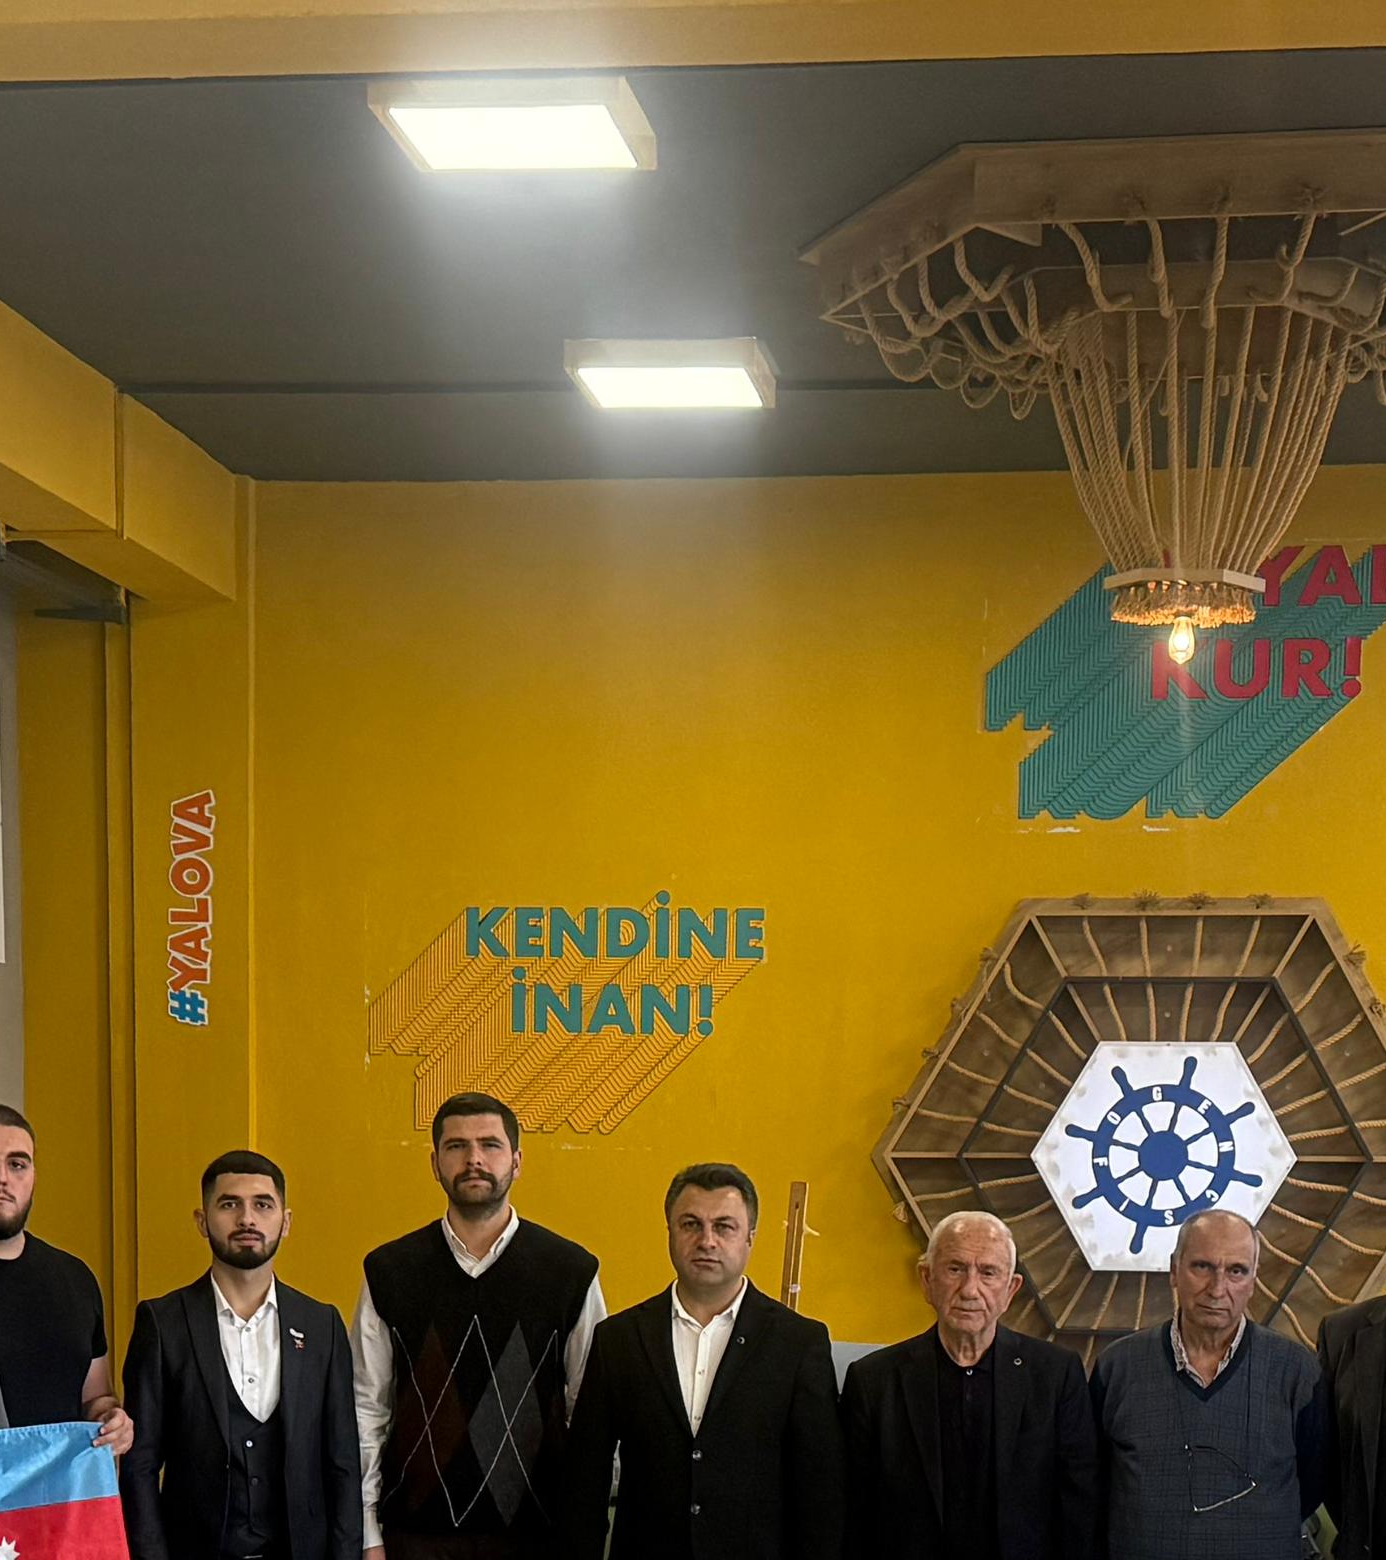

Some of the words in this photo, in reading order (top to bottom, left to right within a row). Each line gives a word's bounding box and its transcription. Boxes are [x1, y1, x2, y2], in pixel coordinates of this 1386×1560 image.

[1150, 636, 1363, 700] KUR!
[166, 789, 216, 1026] #YALOVA
[465, 889, 766, 959] KENDİNE
[511, 966, 714, 1036] İNAN!
